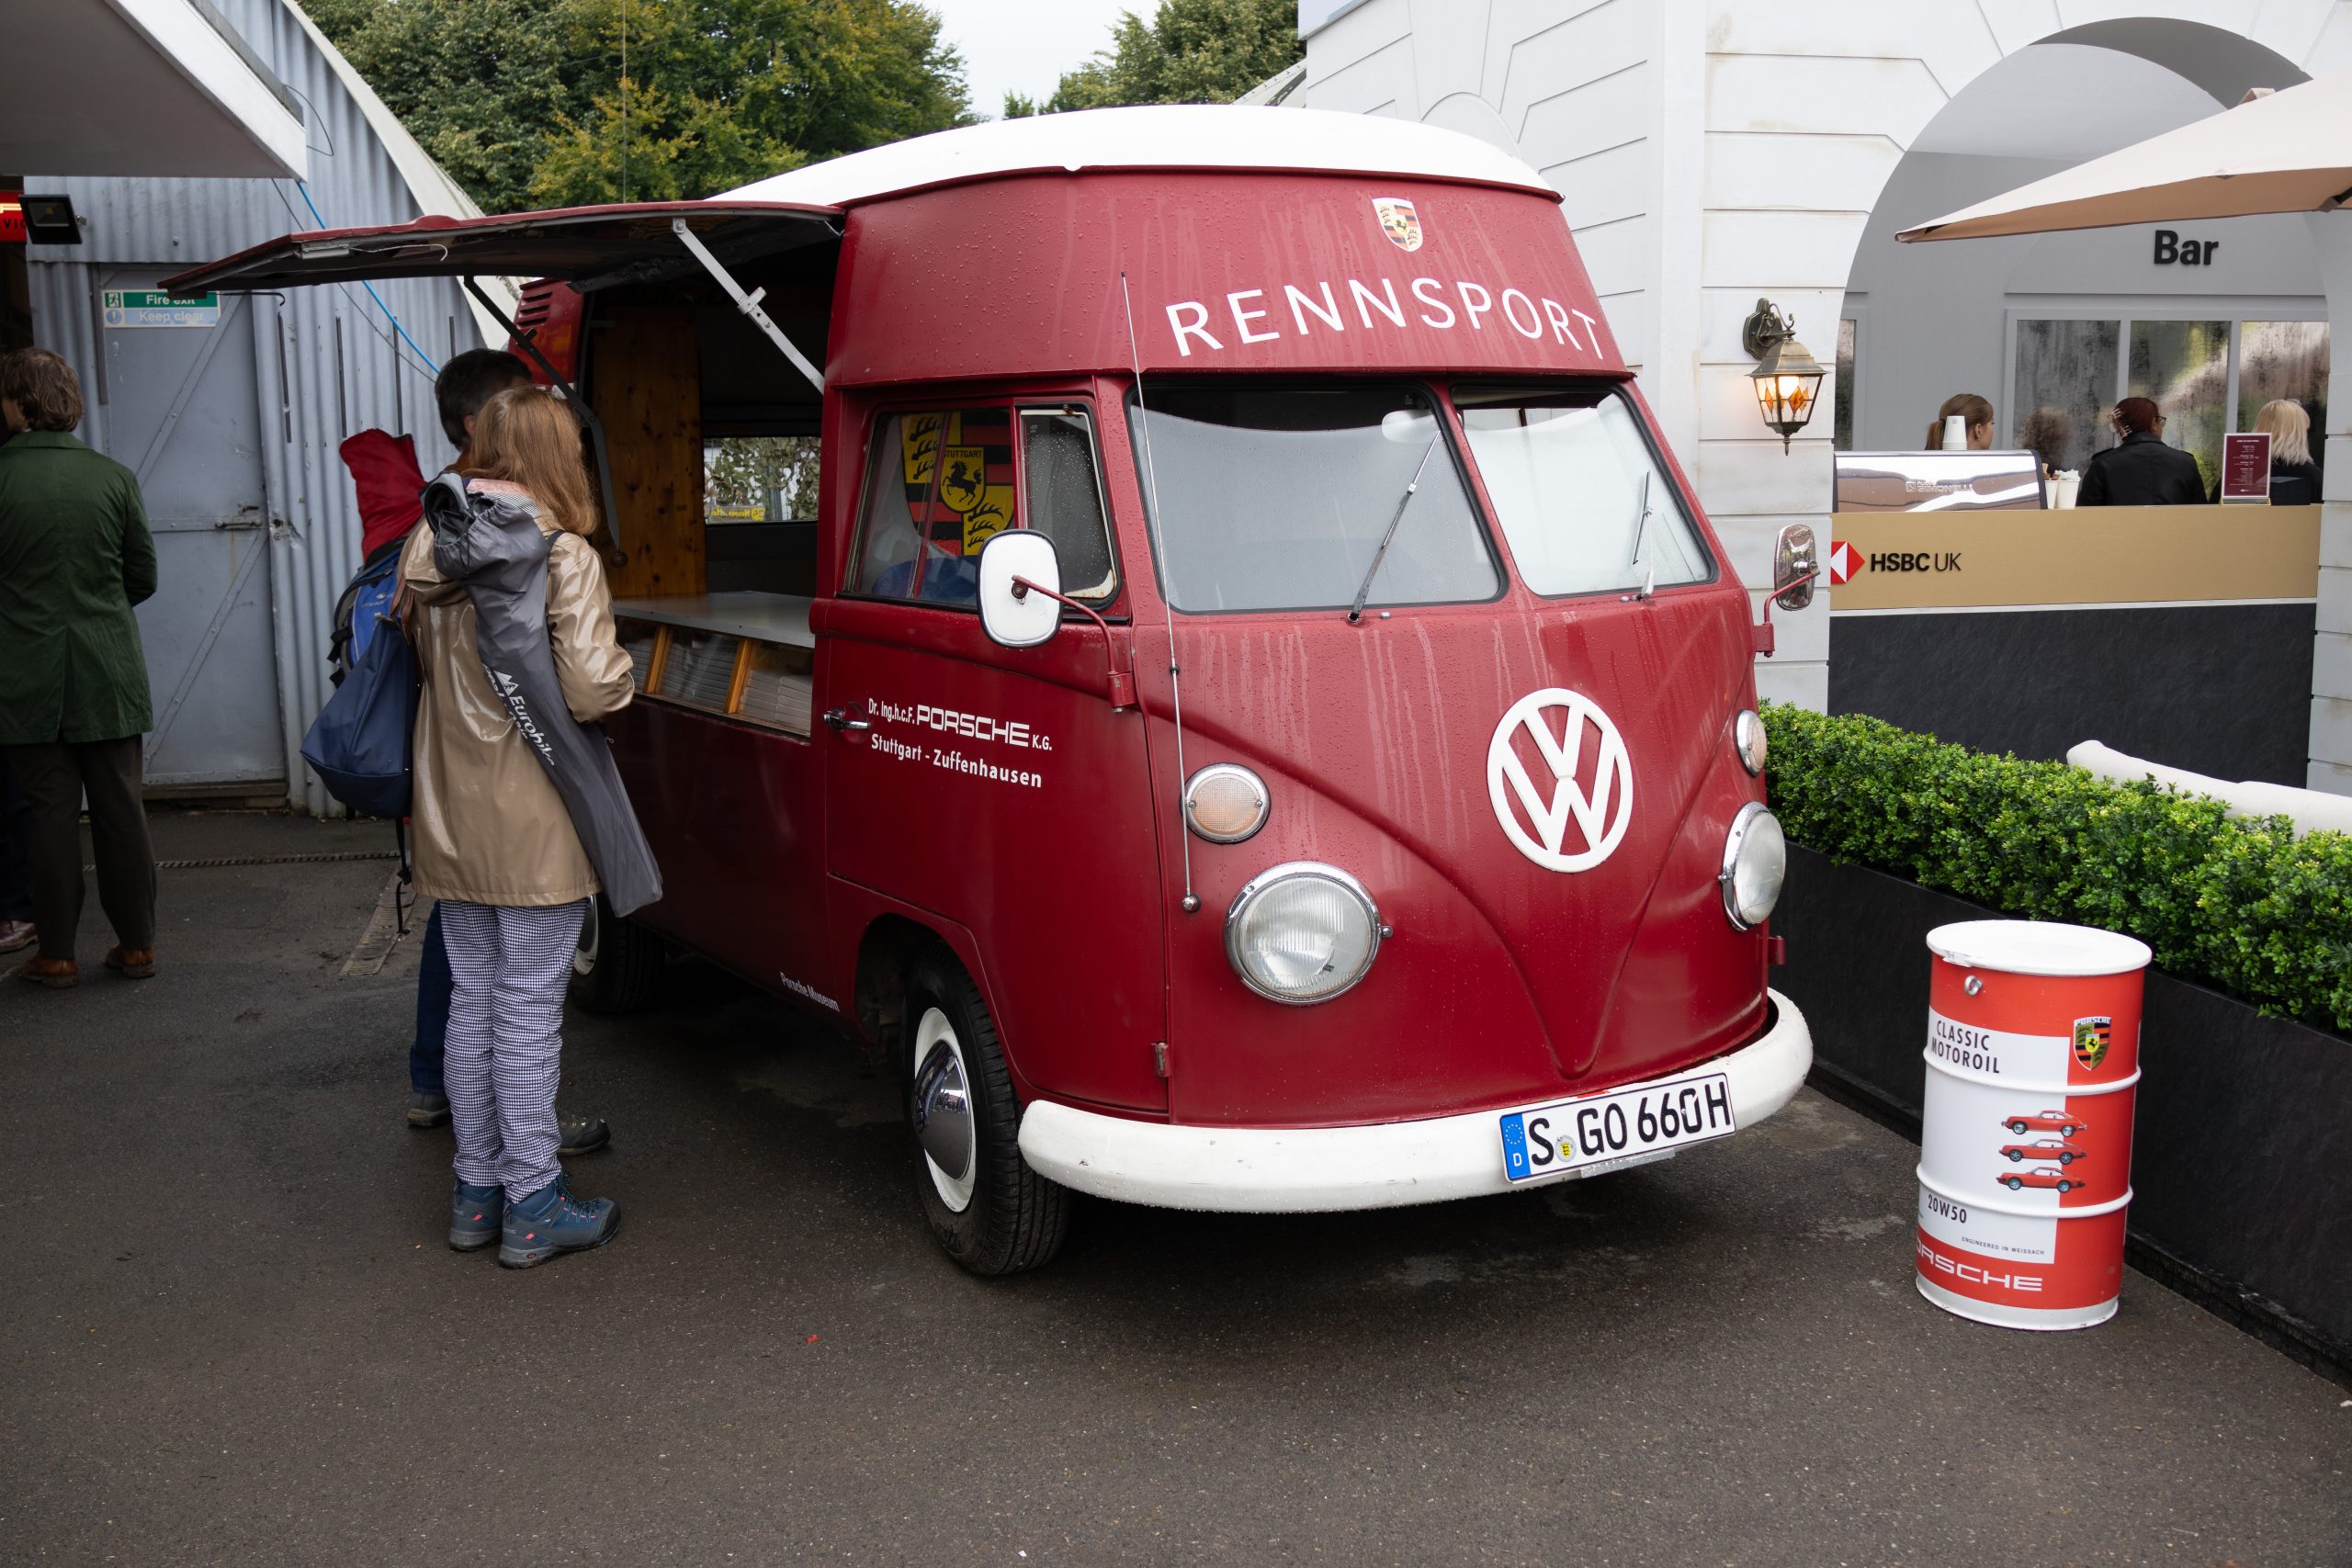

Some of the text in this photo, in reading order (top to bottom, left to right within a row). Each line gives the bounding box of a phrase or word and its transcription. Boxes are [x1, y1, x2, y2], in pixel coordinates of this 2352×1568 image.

[2153, 230, 2220, 265] Bar
[139, 310, 205, 322] Keep clear
[146, 294, 170, 305] Fire
[1165, 277, 1604, 359] RENNSPORT
[1871, 552, 1962, 572] HSBC UK
[868, 697, 879, 716] Dr.
[916, 704, 1030, 748] PORSCHE
[1032, 734, 1053, 751] K.G.
[871, 733, 922, 761] Stuttgart
[933, 749, 1043, 788] Zuffenhausen
[1937, 1020, 1990, 1051] CLASSIC
[1931, 1035, 2000, 1074] MOTOROIL
[1528, 1117, 1555, 1166] S
[1512, 1152, 1523, 1168] D
[1928, 1194, 1967, 1224] 20W50
[1962, 1235, 1999, 1250] ENGINEERED
[2011, 1247, 2045, 1256] WEISSACH
[1917, 1236, 2043, 1292] ORSCHE
